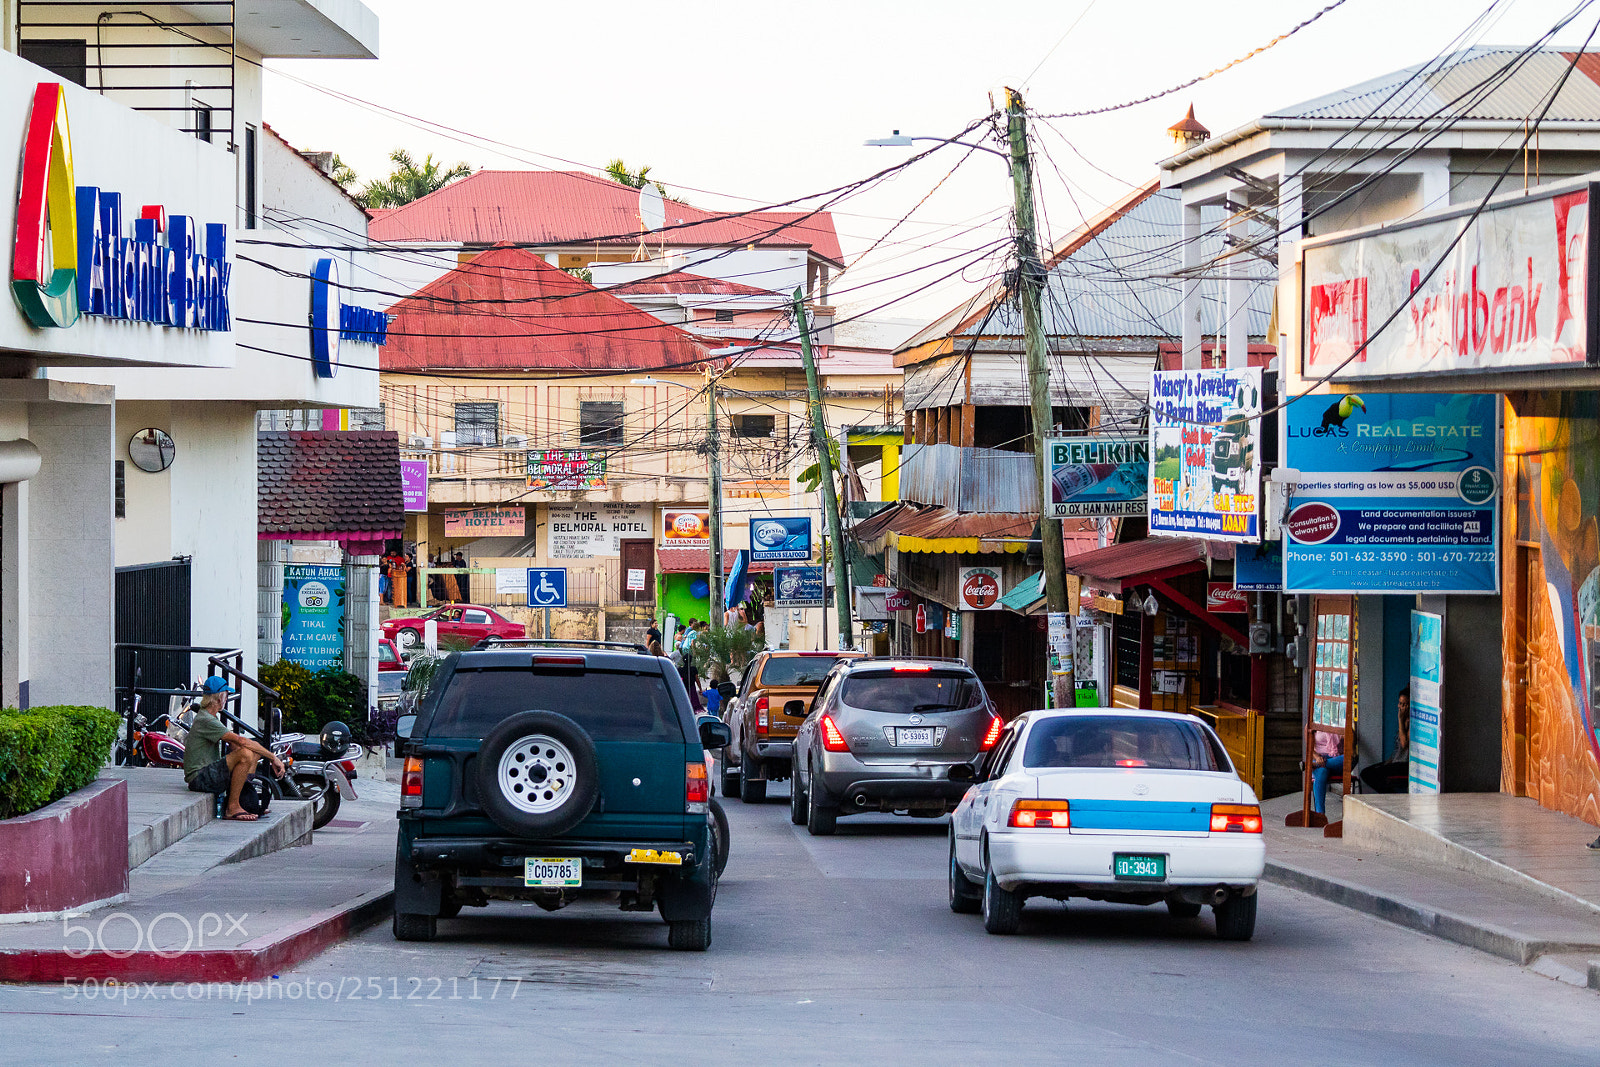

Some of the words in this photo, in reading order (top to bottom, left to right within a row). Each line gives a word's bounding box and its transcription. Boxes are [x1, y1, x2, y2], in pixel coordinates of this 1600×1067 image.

[1153, 373, 1193, 402] Nancy's
[1194, 373, 1239, 402] Jewelry
[1166, 400, 1194, 424] Pawn
[1196, 400, 1223, 427] Shop
[1181, 427, 1199, 445] Cash
[1200, 427, 1213, 445] for
[1053, 441, 1149, 466] BELIKIN
[1337, 441, 1347, 454] &
[1352, 440, 1402, 458] Company
[1405, 439, 1448, 453] Limited
[545, 450, 564, 461] THE
[1186, 447, 1206, 467] Gold
[527, 462, 574, 475] BELMORAL
[576, 463, 606, 475] HOTEL
[1153, 477, 1174, 495] Titled
[1297, 481, 1332, 491] operties
[1333, 481, 1364, 491] starting
[1379, 481, 1395, 489] low
[1408, 480, 1436, 491] $5,000
[1438, 481, 1455, 489] USD
[1055, 504, 1067, 514] KO
[1069, 504, 1081, 514] OX
[1083, 503, 1101, 514] HAN
[1104, 503, 1123, 514] NAH
[1125, 502, 1148, 513] REST
[1159, 497, 1174, 512] Land
[1213, 493, 1230, 512] CAR
[446, 511, 468, 519] NEW
[473, 510, 524, 518] BELMORAL
[574, 511, 598, 521] THE
[1360, 510, 1381, 518] Land
[1382, 510, 1446, 518] documentation
[1447, 510, 1476, 518] issues?
[465, 518, 505, 527] HOTEL
[553, 523, 607, 532] BELMORAL
[613, 522, 647, 532] HOTEL
[1289, 515, 1330, 528] Consultation
[1373, 523, 1407, 532] prepare
[1408, 522, 1425, 530] and
[1427, 522, 1463, 530] facilitate
[1464, 522, 1479, 530] ALL
[1294, 526, 1318, 536] always
[1318, 522, 1335, 531] FREE
[1345, 535, 1367, 544] legal
[1368, 535, 1415, 543] documents
[1416, 535, 1459, 544] pertaining
[1459, 535, 1468, 543] to
[1470, 535, 1492, 543] land.
[754, 551, 782, 559] DELICIOUS
[1287, 552, 1327, 562] Phone:
[1330, 551, 1407, 562] 501-632-3590
[1417, 551, 1495, 562] 501-670-7222
[289, 567, 316, 576] KATUN
[318, 567, 340, 576] AHAU
[301, 620, 326, 628] TIKAL
[289, 633, 314, 641] A.T.M
[315, 633, 337, 641] CAVE
[285, 647, 306, 655] CAVE
[309, 647, 341, 655] TUBING
[317, 659, 343, 667] CREEK
[534, 865, 572, 878] C05785
